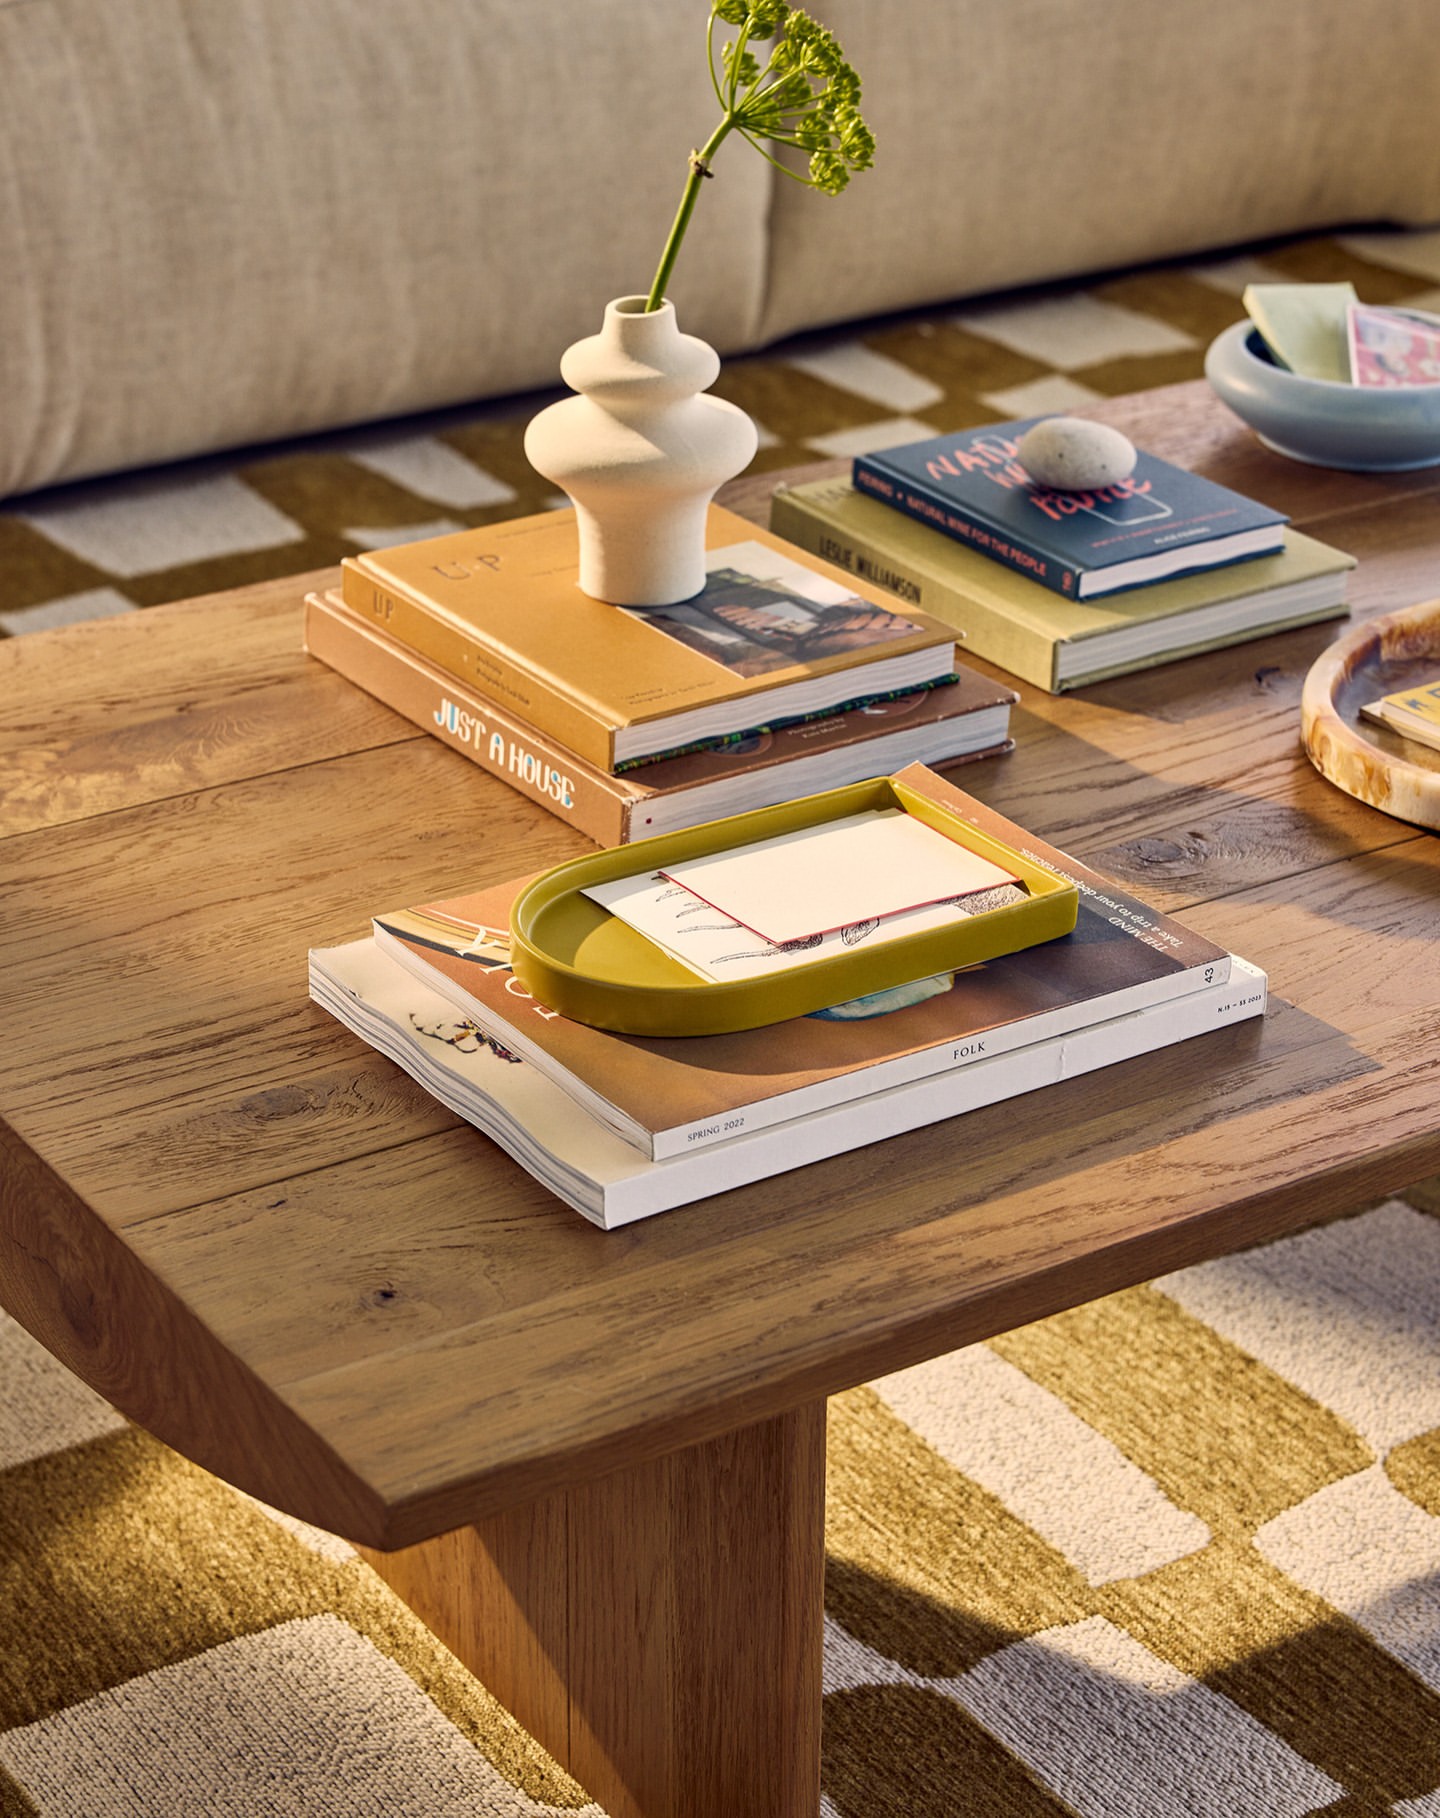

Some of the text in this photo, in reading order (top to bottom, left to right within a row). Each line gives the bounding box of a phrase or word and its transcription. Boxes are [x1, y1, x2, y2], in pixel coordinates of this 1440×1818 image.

[972, 528, 990, 546] FOR
[991, 538, 1009, 557] THE
[1010, 548, 1046, 577] PEOPLE
[819, 534, 921, 604] LESLIE WILLIAMSON
[373, 590, 393, 619] UP
[433, 698, 575, 809] JUST A HOUSE
[1060, 872, 1096, 896] deepest
[1095, 895, 1125, 911] your
[1119, 908, 1132, 917] to
[1131, 914, 1152, 929] trip
[1108, 916, 1168, 952] THE MIND
[1158, 931, 1184, 949] Take
[1204, 967, 1214, 984] 43
[953, 1041, 986, 1060] FOLK
[687, 1117, 745, 1143] SPRING 2022
